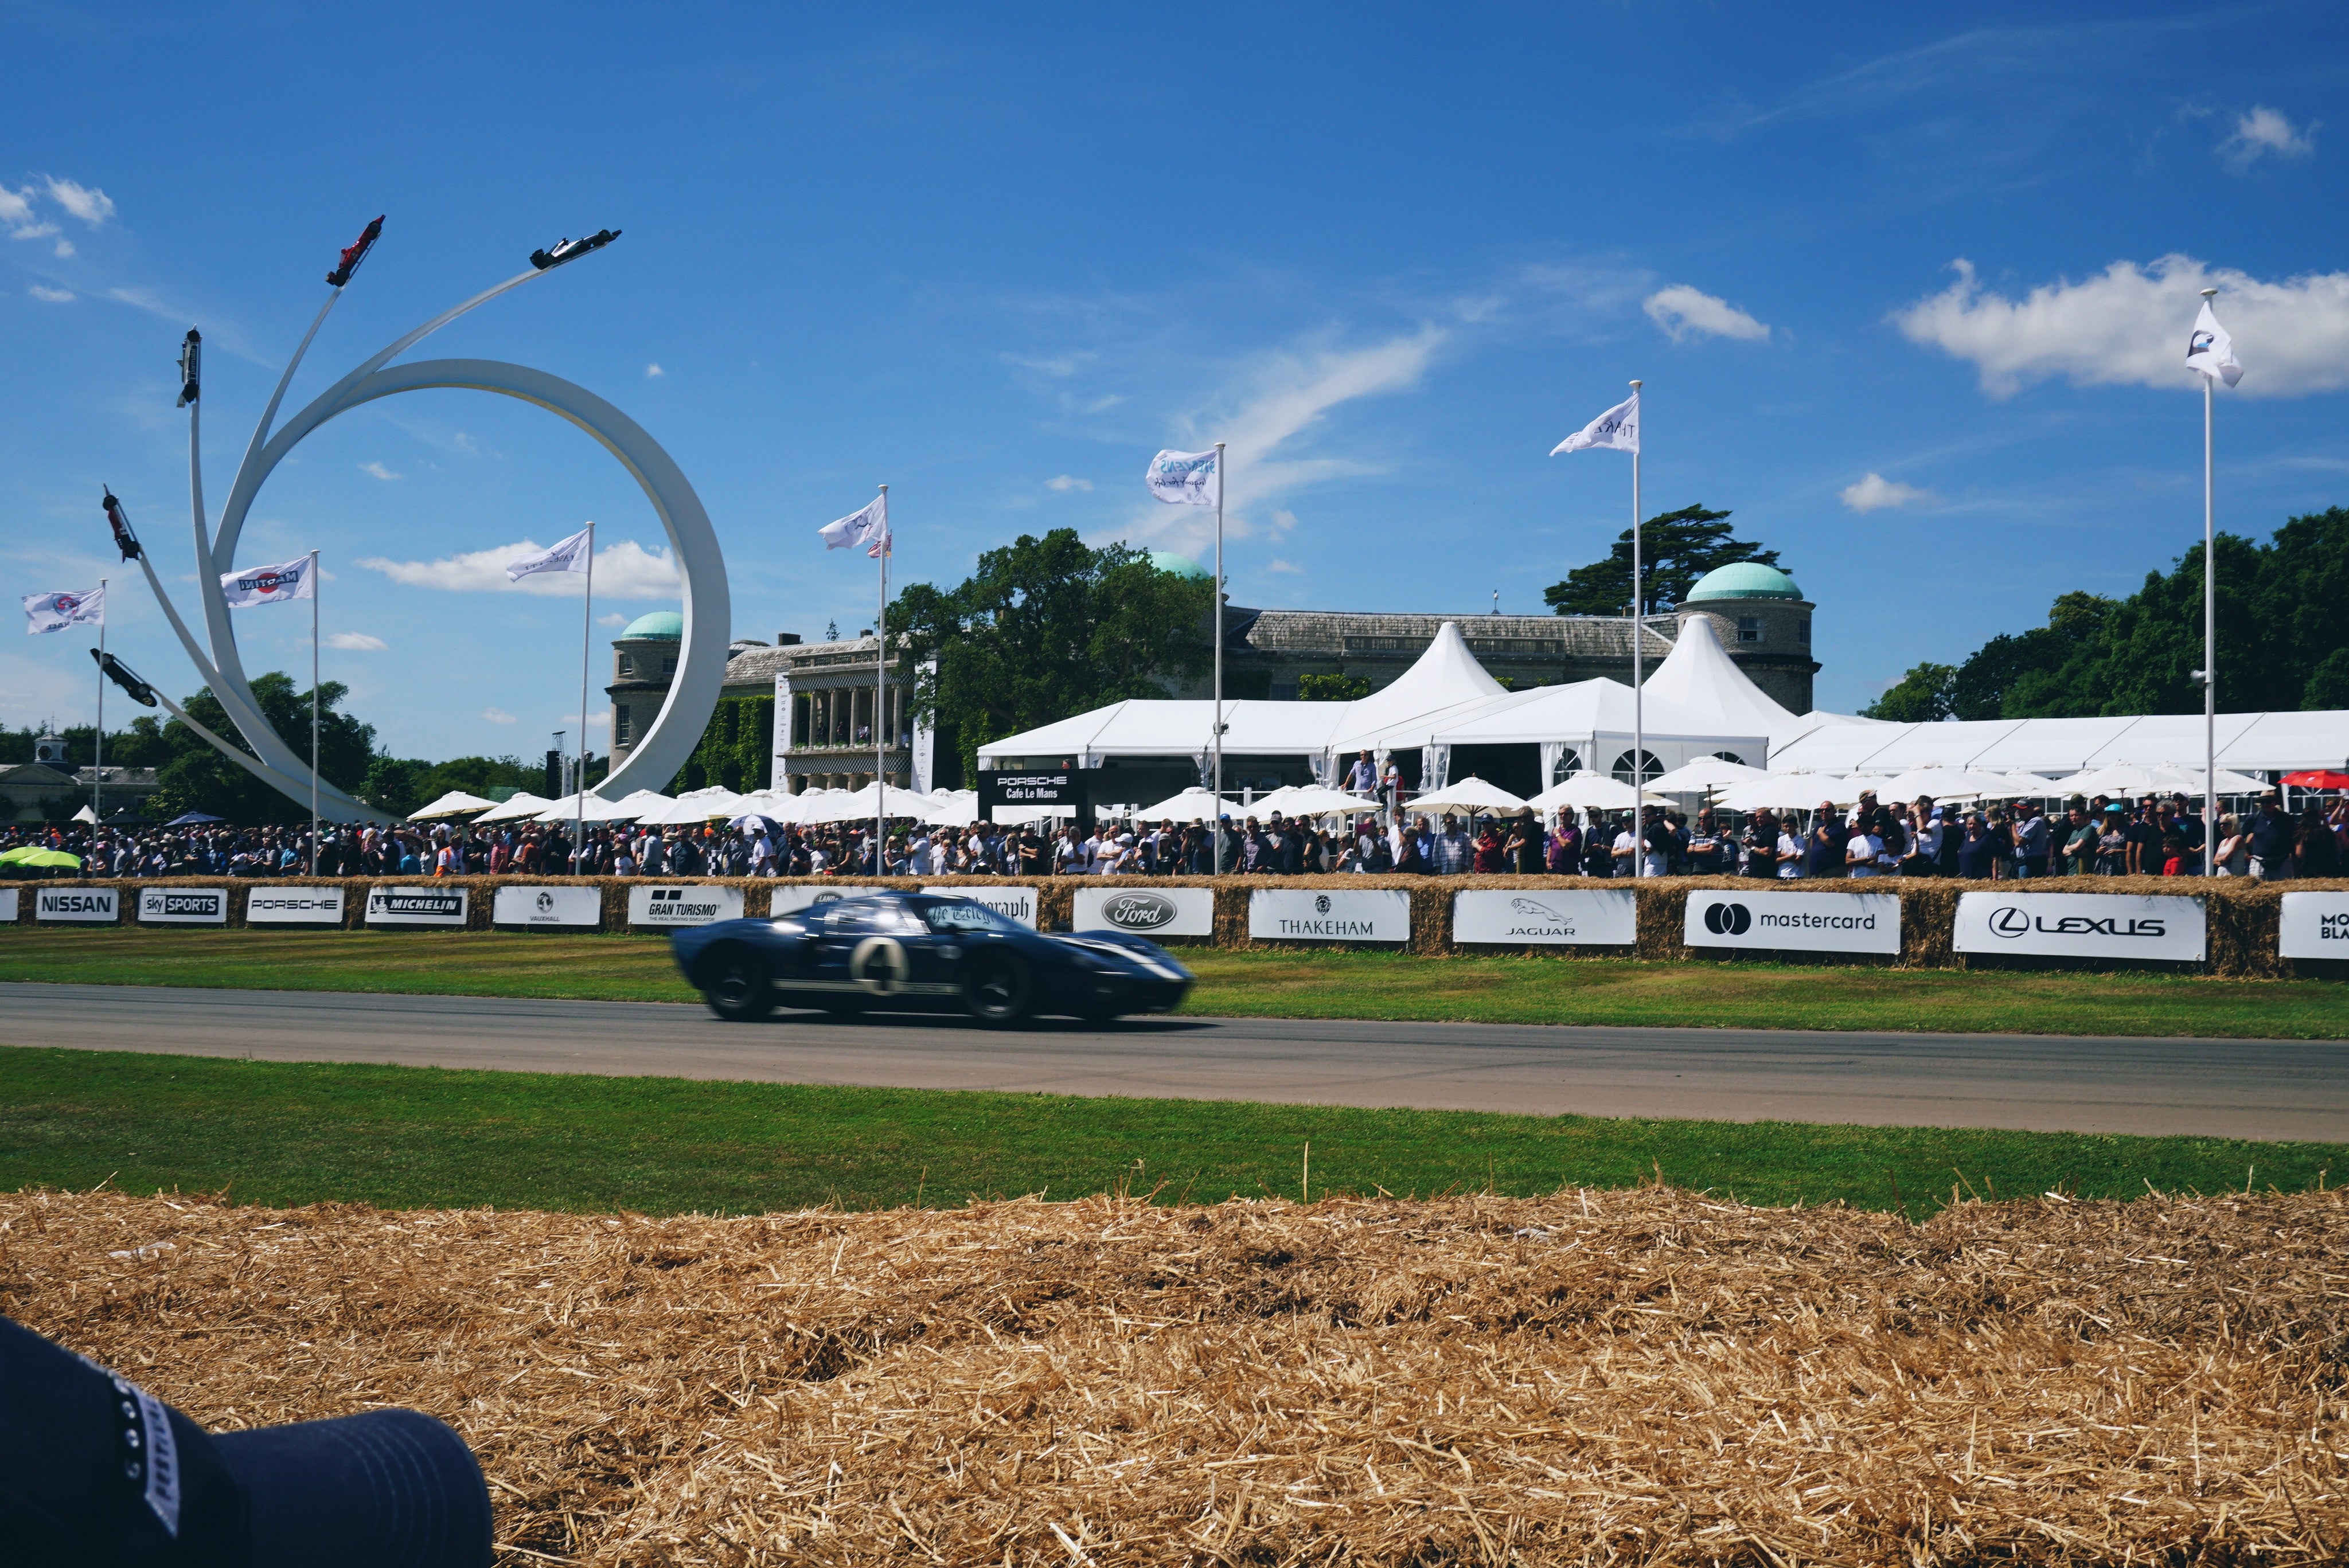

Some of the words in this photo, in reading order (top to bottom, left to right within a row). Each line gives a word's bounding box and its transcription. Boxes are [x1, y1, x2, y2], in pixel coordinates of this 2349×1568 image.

[997, 776, 1067, 786] PORSCHE
[1006, 788, 1024, 799] Café
[1025, 788, 1035, 798] Le
[1036, 788, 1058, 799] Mans
[42, 896, 111, 912] NISSAN
[146, 898, 163, 912] sky
[167, 898, 216, 912] SPORTS
[251, 900, 338, 910] PORSCHE
[391, 899, 457, 910] MICHELIN
[649, 904, 674, 916] GRAN
[1114, 897, 1162, 923] Ford
[1279, 920, 1373, 935] THAKEHAM
[1761, 913, 1875, 930] mastercard
[2036, 916, 2165, 937] LEXUS
[1505, 928, 1575, 936] JAGUAR
